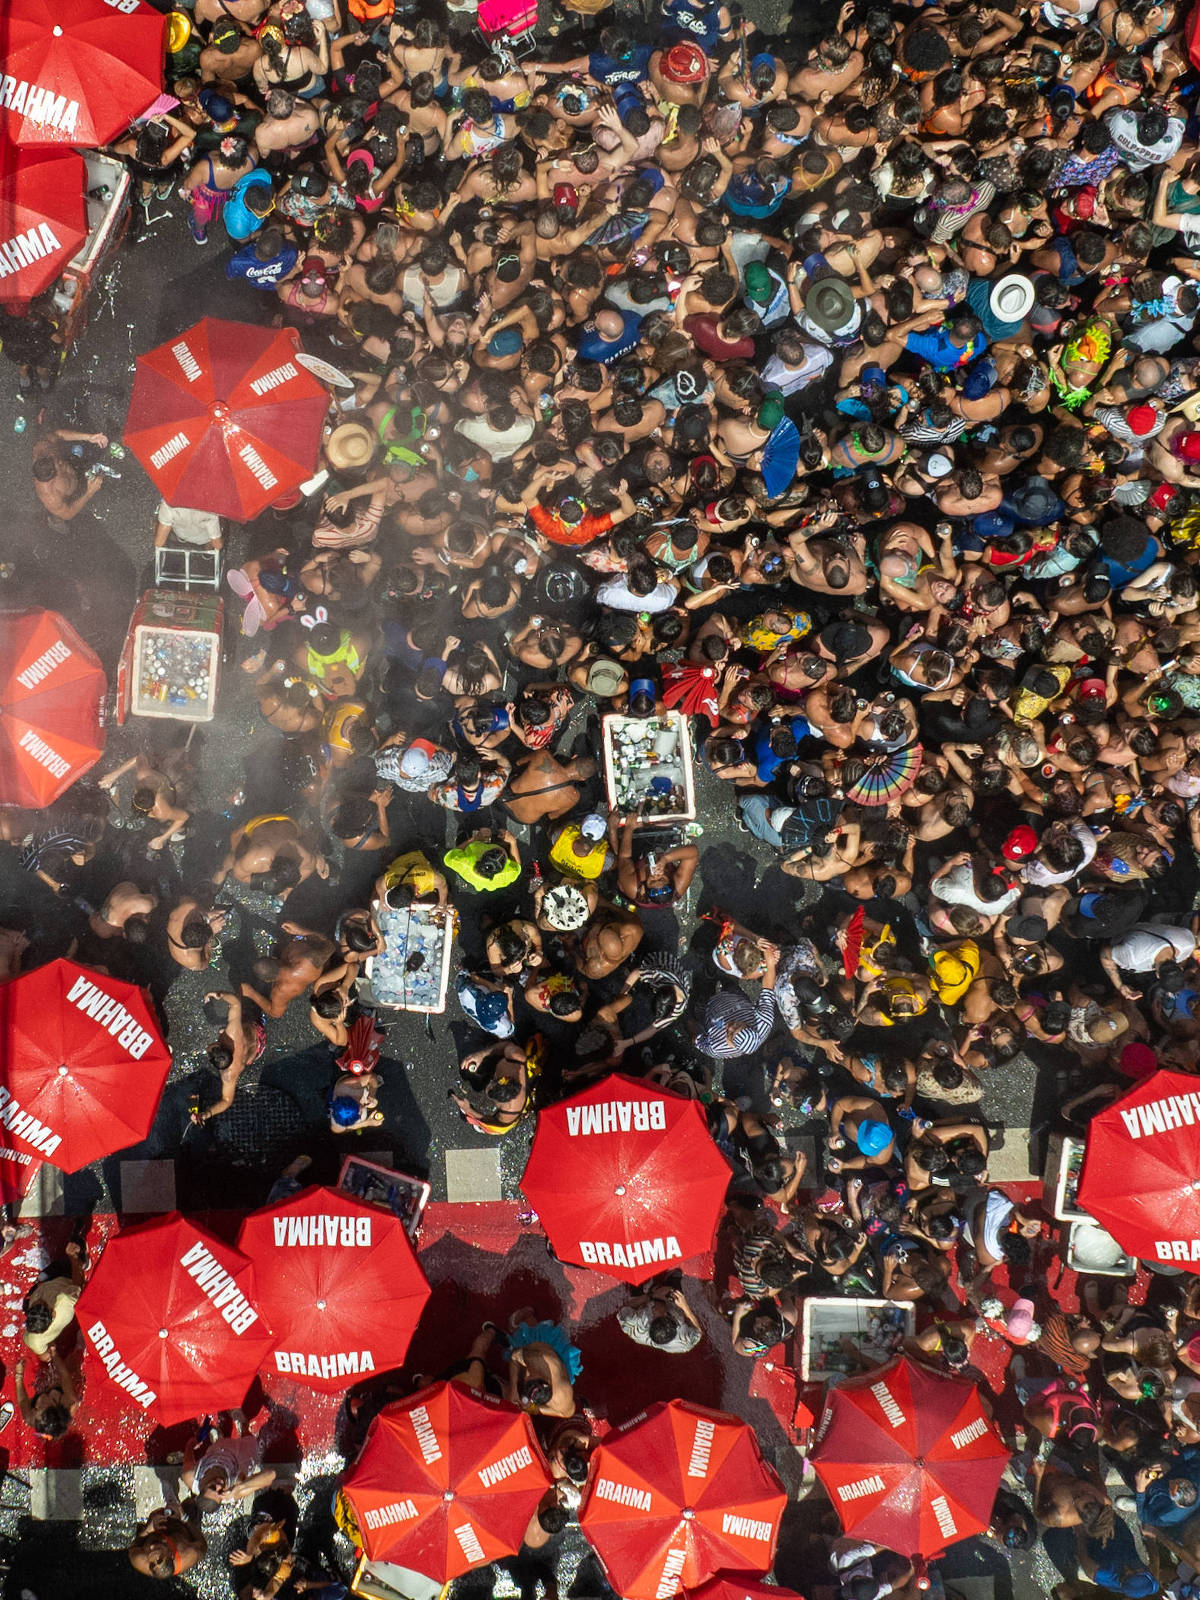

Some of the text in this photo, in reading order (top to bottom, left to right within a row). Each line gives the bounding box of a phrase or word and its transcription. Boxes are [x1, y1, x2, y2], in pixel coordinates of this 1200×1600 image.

[172, 342, 202, 382] BRAHMA
[250, 363, 298, 396] BRAHMA
[150, 432, 190, 469] BRAHMA
[239, 444, 278, 490] BRAHMA
[17, 641, 71, 689] BRAHMA
[19, 729, 71, 778] BRAHMA
[67, 976, 153, 1059] BRAHMA
[567, 1101, 666, 1136] BRAHMA
[274, 1215, 371, 1246] BRAHMA
[580, 1237, 682, 1268] BRAHMA
[180, 1241, 258, 1335] BRAHMA
[88, 1321, 156, 1408] BRAHMA
[275, 1351, 374, 1379] BRAHMA
[871, 1382, 906, 1428] BRAHMA
[409, 1406, 442, 1465] BRAHMA
[688, 1420, 714, 1478] BRAHMA
[951, 1418, 988, 1449] BRAHMA
[478, 1446, 532, 1488] BRAHMA
[596, 1479, 651, 1512] BRAHMA
[837, 1475, 885, 1501] BRAHMA
[364, 1500, 419, 1529] BRAHMA
[723, 1514, 772, 1541] BRAHMA
[931, 1496, 957, 1538] BRAHMA
